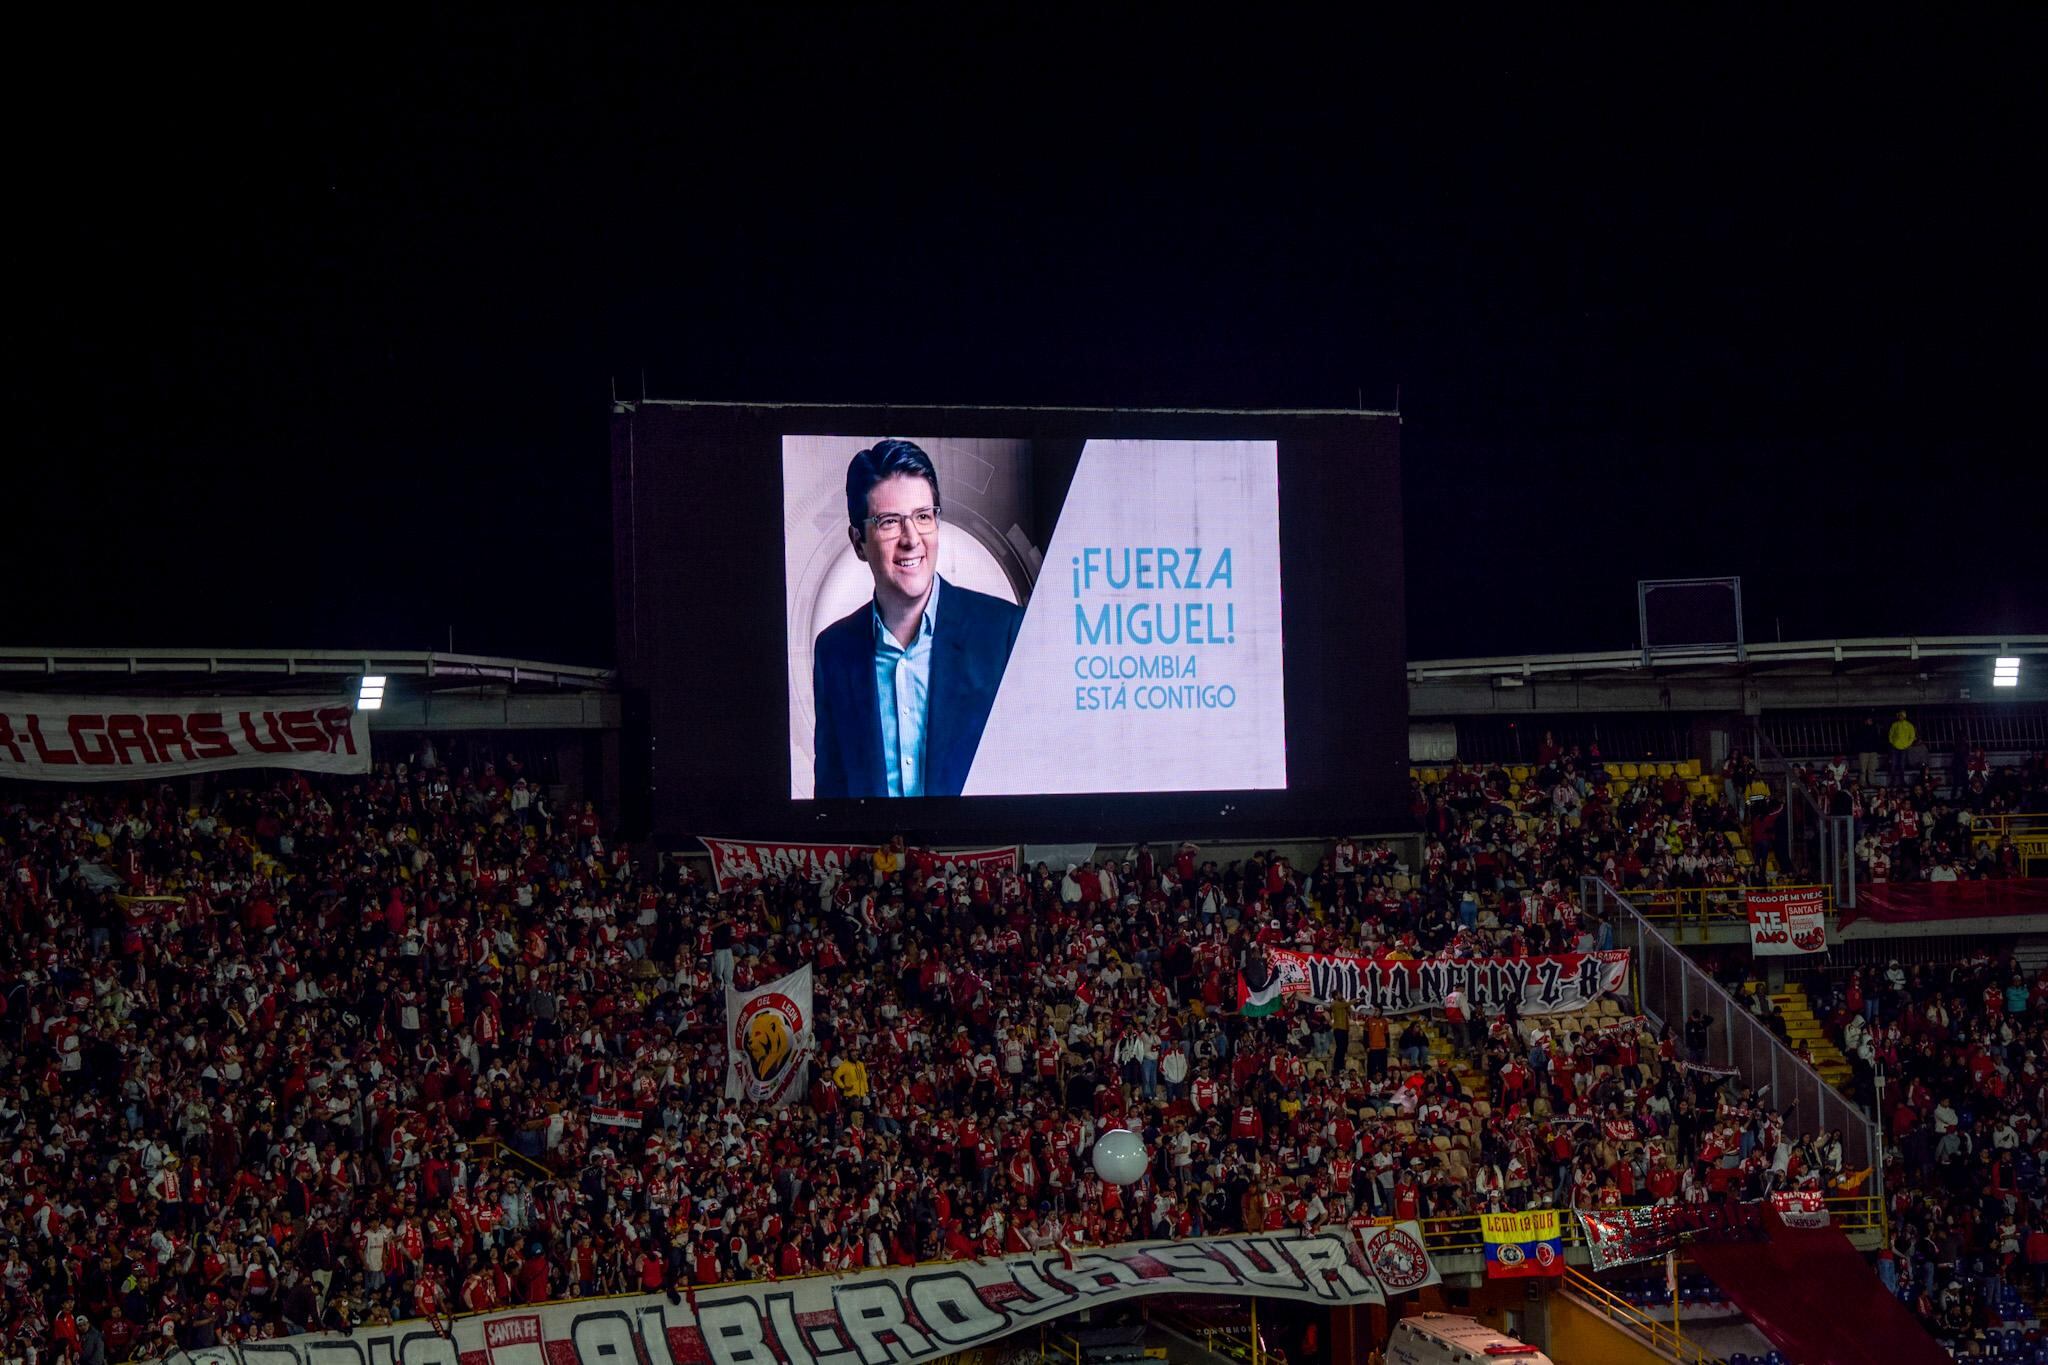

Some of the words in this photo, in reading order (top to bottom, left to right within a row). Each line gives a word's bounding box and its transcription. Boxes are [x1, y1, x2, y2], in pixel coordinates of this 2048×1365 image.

[1072, 547, 1233, 598] ¡FUERZA
[1075, 603, 1235, 645] MIGUEL!
[1074, 655, 1196, 679] COLOMBIA
[1076, 682, 1126, 710] ESTÁ
[1134, 684, 1236, 709] CONTIGO
[239, 706, 357, 754] USA
[1748, 895, 1778, 903] LEGADO
[1788, 905, 1813, 915] SANTA
[1814, 903, 1823, 912] FE
[1755, 911, 1783, 930] TE
[1755, 930, 1788, 943] AMO
[1309, 956, 1412, 1011] VILLA
[757, 996, 771, 1007] DEL
[1532, 1212, 1553, 1230] SUR
[1140, 1233, 1378, 1301] SUR
[487, 1321, 518, 1343] SANTA
[520, 1320, 538, 1338] FE
